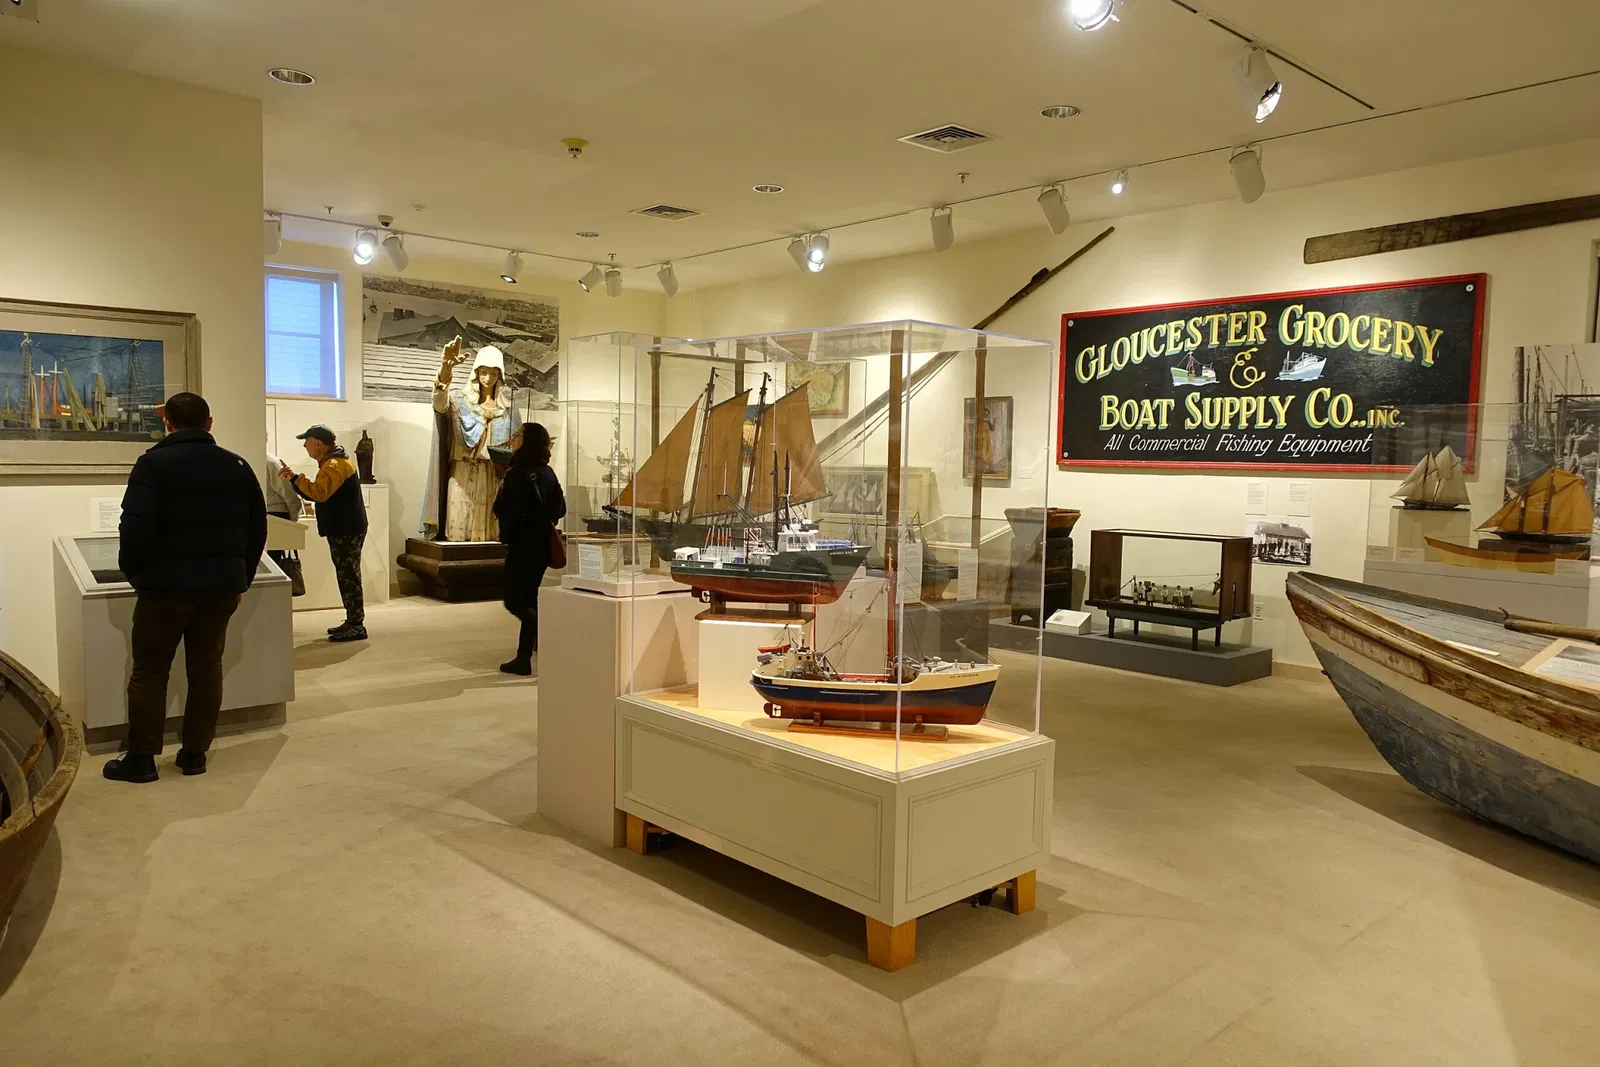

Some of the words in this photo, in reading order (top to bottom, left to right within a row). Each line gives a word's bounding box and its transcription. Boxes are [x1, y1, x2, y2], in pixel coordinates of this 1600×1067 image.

[1075, 310, 1268, 384] GLOUCESTER
[1278, 304, 1443, 367] GROCERY
[1230, 347, 1266, 389] &
[1099, 394, 1175, 431] BOAT
[1184, 391, 1295, 430] SUPPLY
[1103, 434, 1125, 451] All
[1129, 434, 1210, 451] Commercial
[1215, 433, 1273, 457] Fishing
[1277, 433, 1374, 458] Equipment
